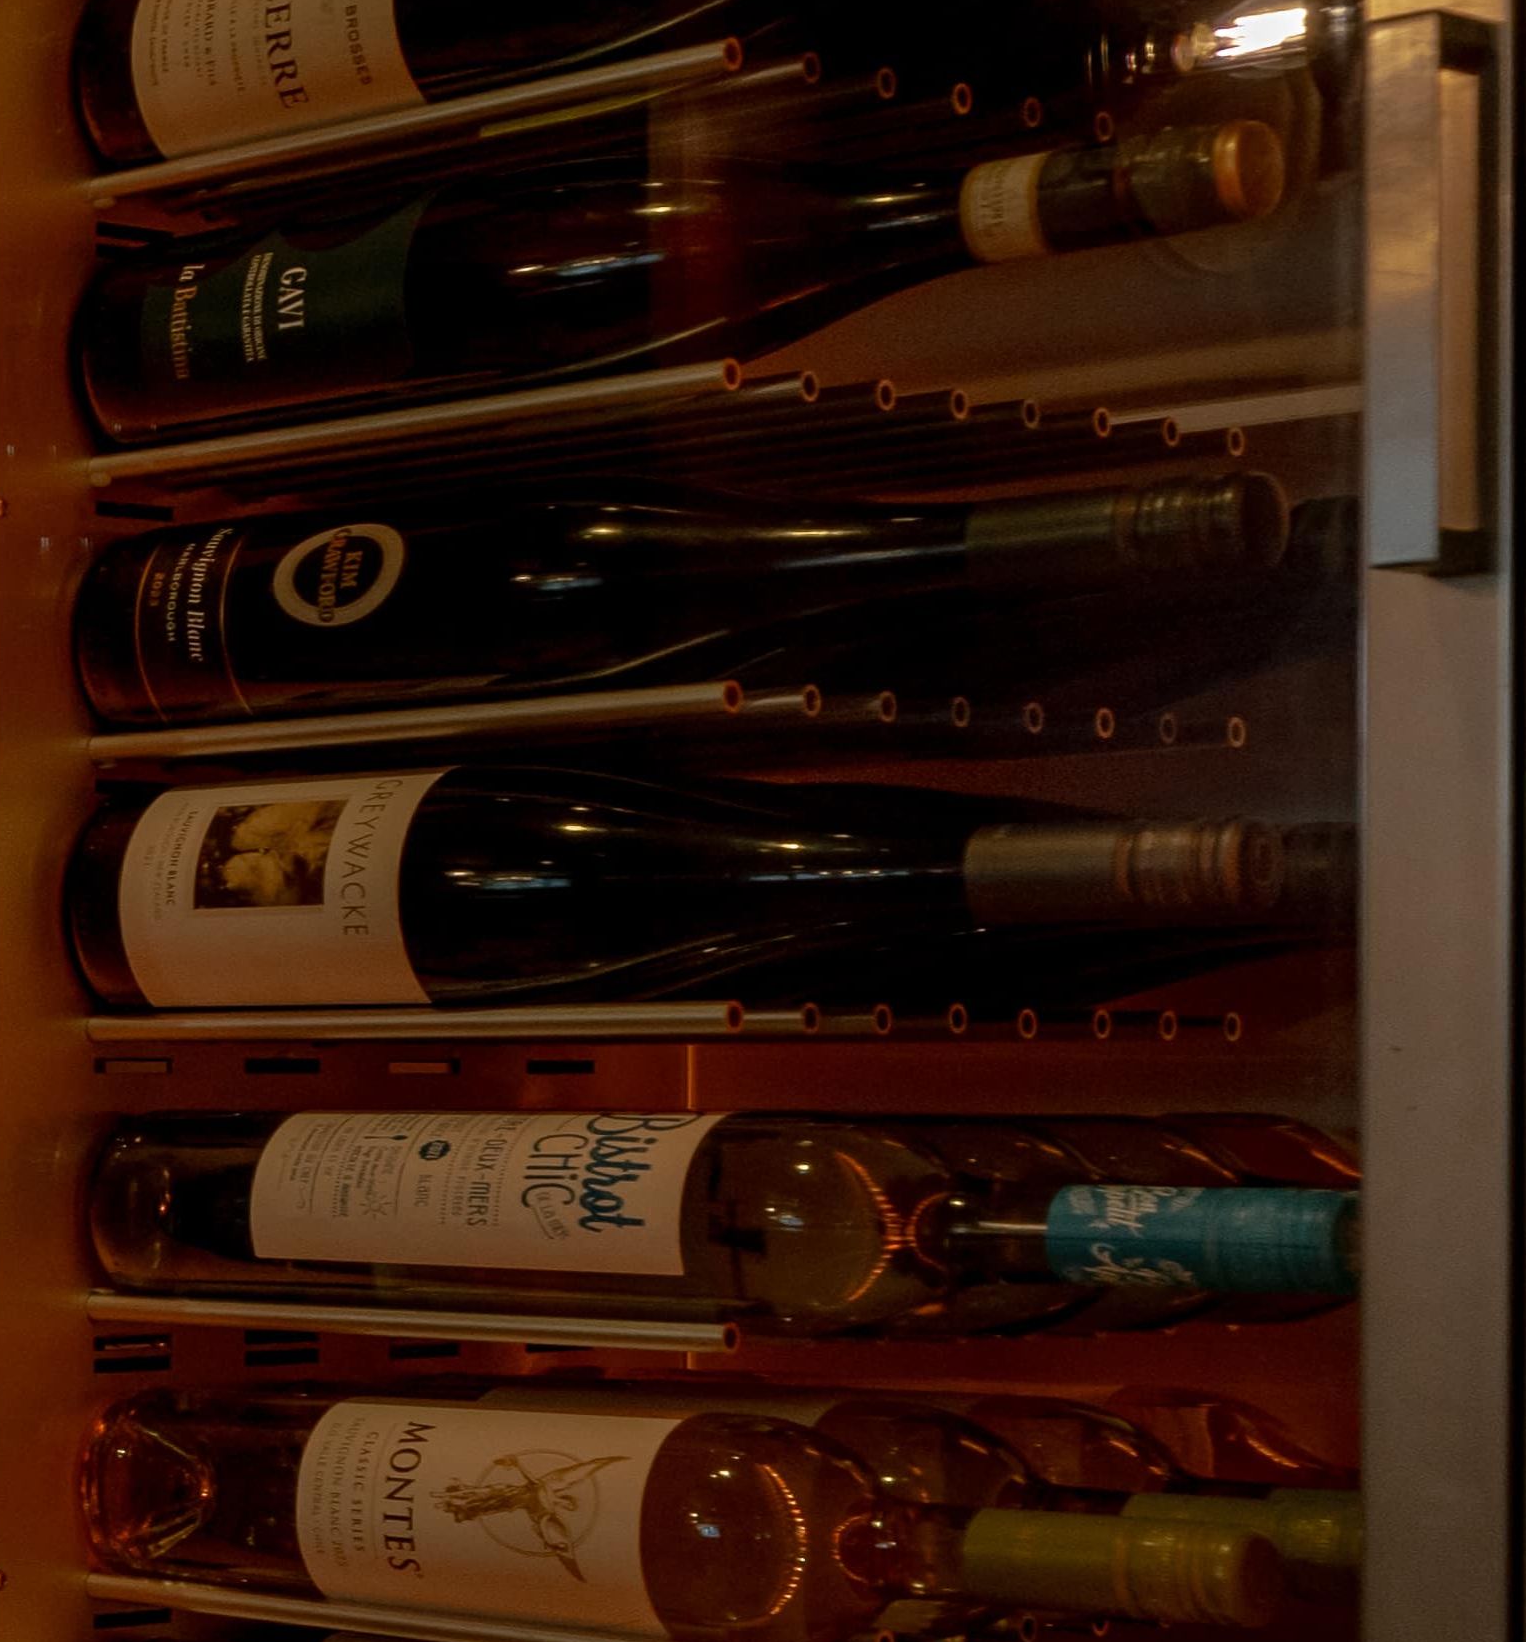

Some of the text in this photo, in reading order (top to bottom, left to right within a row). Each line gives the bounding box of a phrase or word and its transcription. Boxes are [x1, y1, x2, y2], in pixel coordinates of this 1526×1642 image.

[345, 4, 373, 85] BROSSES
[169, 285, 200, 380] Battistina
[276, 265, 309, 331] GAVI
[186, 527, 235, 663] Sauvignon Blanc
[316, 528, 353, 624] CRAWFORD
[340, 550, 364, 588] KIM
[165, 808, 200, 907] SAUVIGNON BLANC
[339, 779, 404, 937] GREYWACKE
[578, 1112, 700, 1233] Bistrot
[329, 1417, 365, 1536] SAUVIGNON BLANC
[350, 1431, 380, 1554] CLASSIC SERIES
[382, 1421, 438, 1573] MONTES
